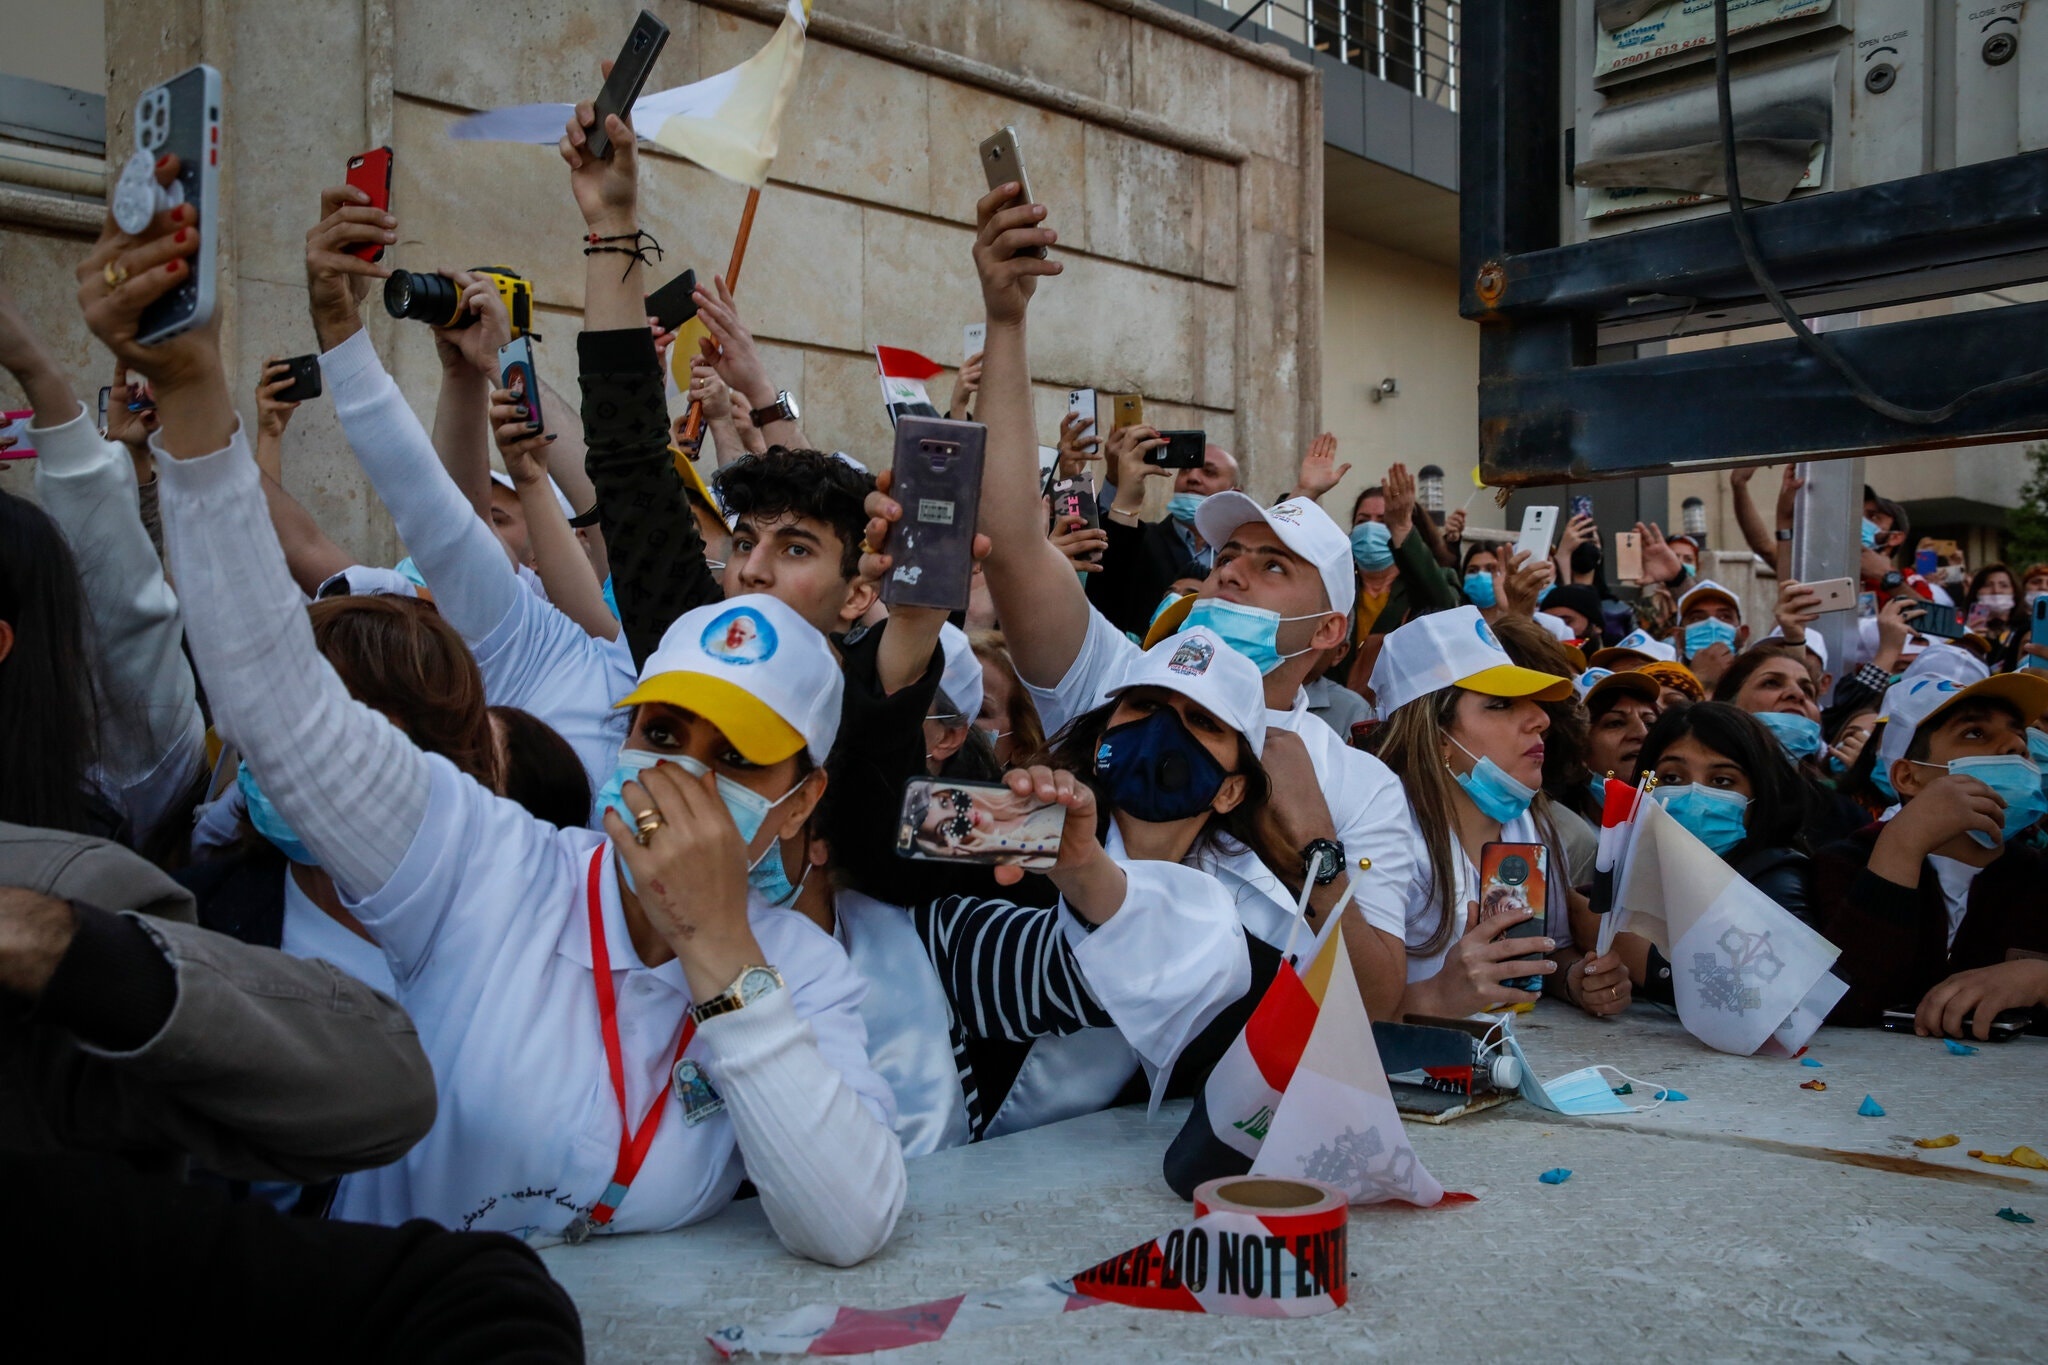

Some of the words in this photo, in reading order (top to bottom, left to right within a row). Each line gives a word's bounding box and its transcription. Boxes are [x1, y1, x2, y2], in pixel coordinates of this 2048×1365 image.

[1968, 7, 1996, 20] CLOSE
[2000, 1, 2024, 12] OPEN
[1612, 51, 1650, 68] 07901
[1653, 42, 1679, 57] 613
[1681, 36, 1707, 49] 848
[1858, 36, 1880, 49] OPEN
[1882, 29, 1909, 42] CLOSE
[1218, 1231, 1287, 1300] NOT
[1296, 1222, 1348, 1299] ENT
